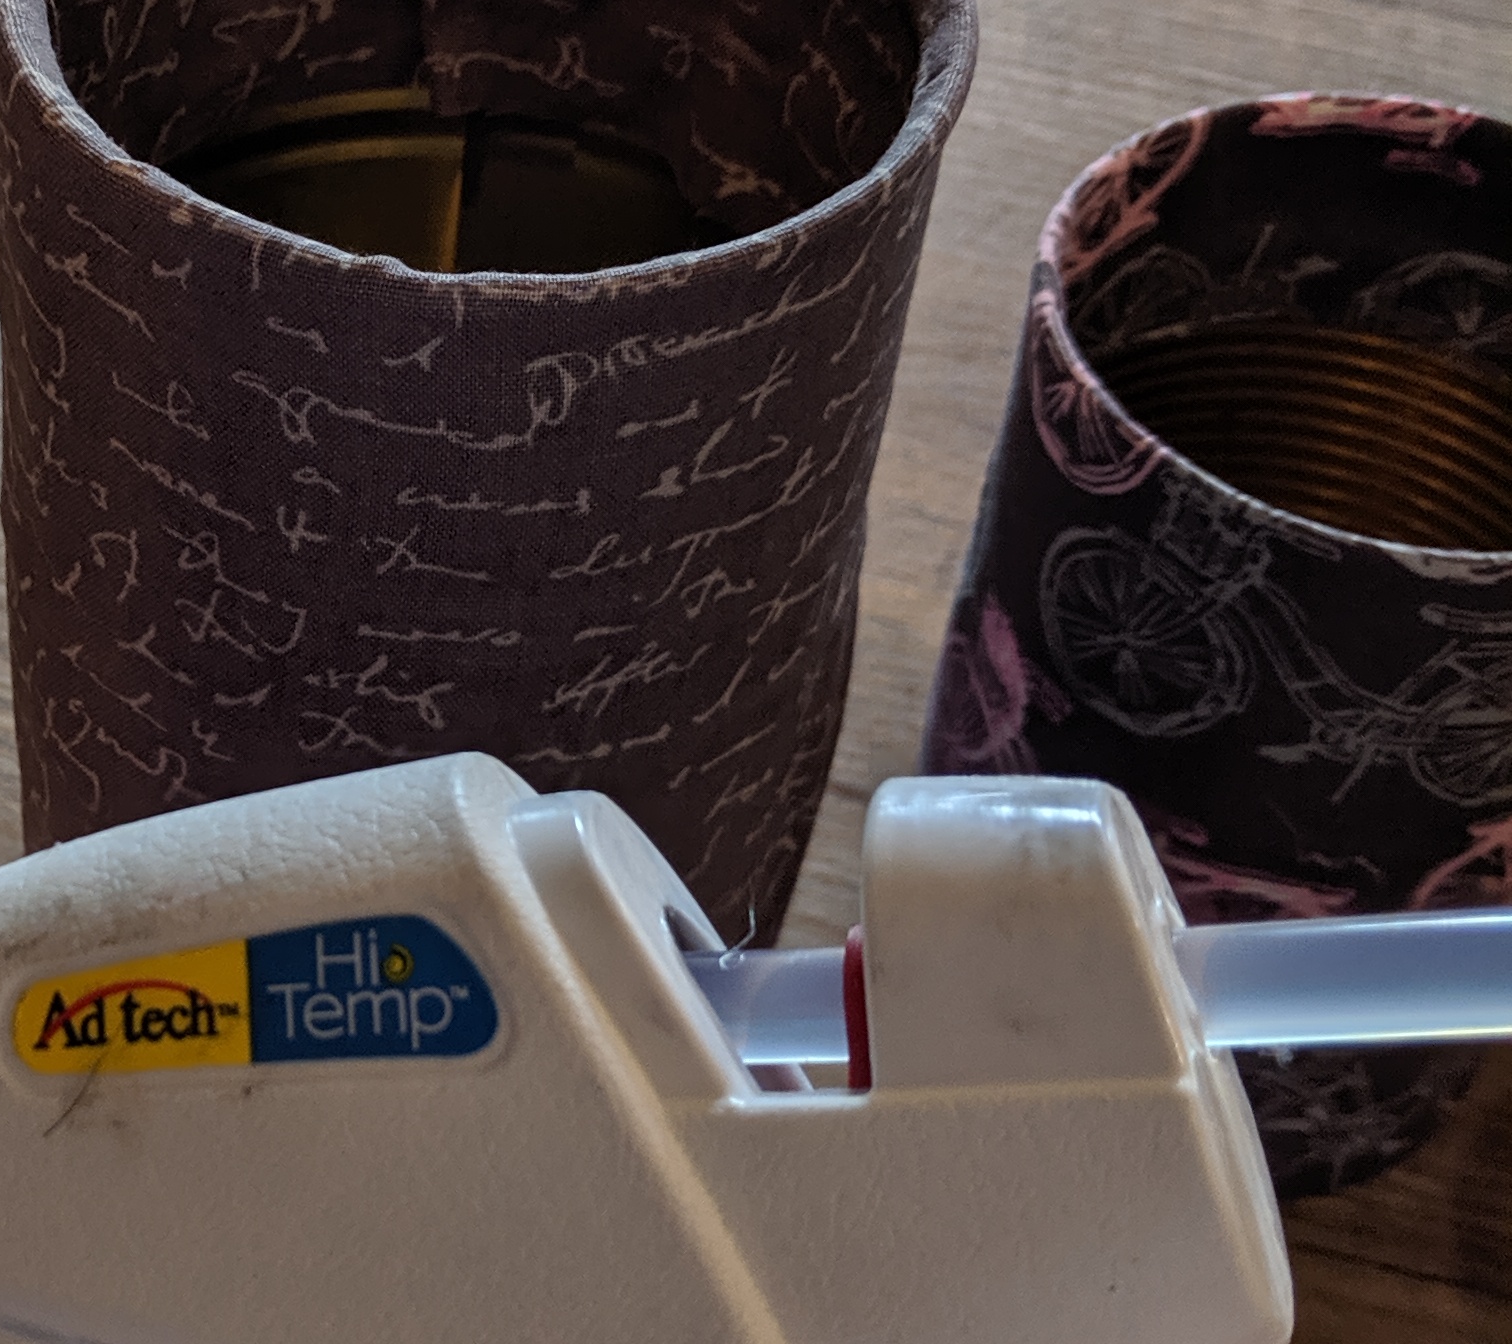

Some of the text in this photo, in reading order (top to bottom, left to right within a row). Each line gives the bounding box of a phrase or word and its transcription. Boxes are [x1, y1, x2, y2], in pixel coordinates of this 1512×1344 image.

[315, 927, 381, 989] Hi
[33, 989, 108, 1050] Ad
[120, 987, 218, 1043] tech
[267, 980, 453, 1051] Temp
